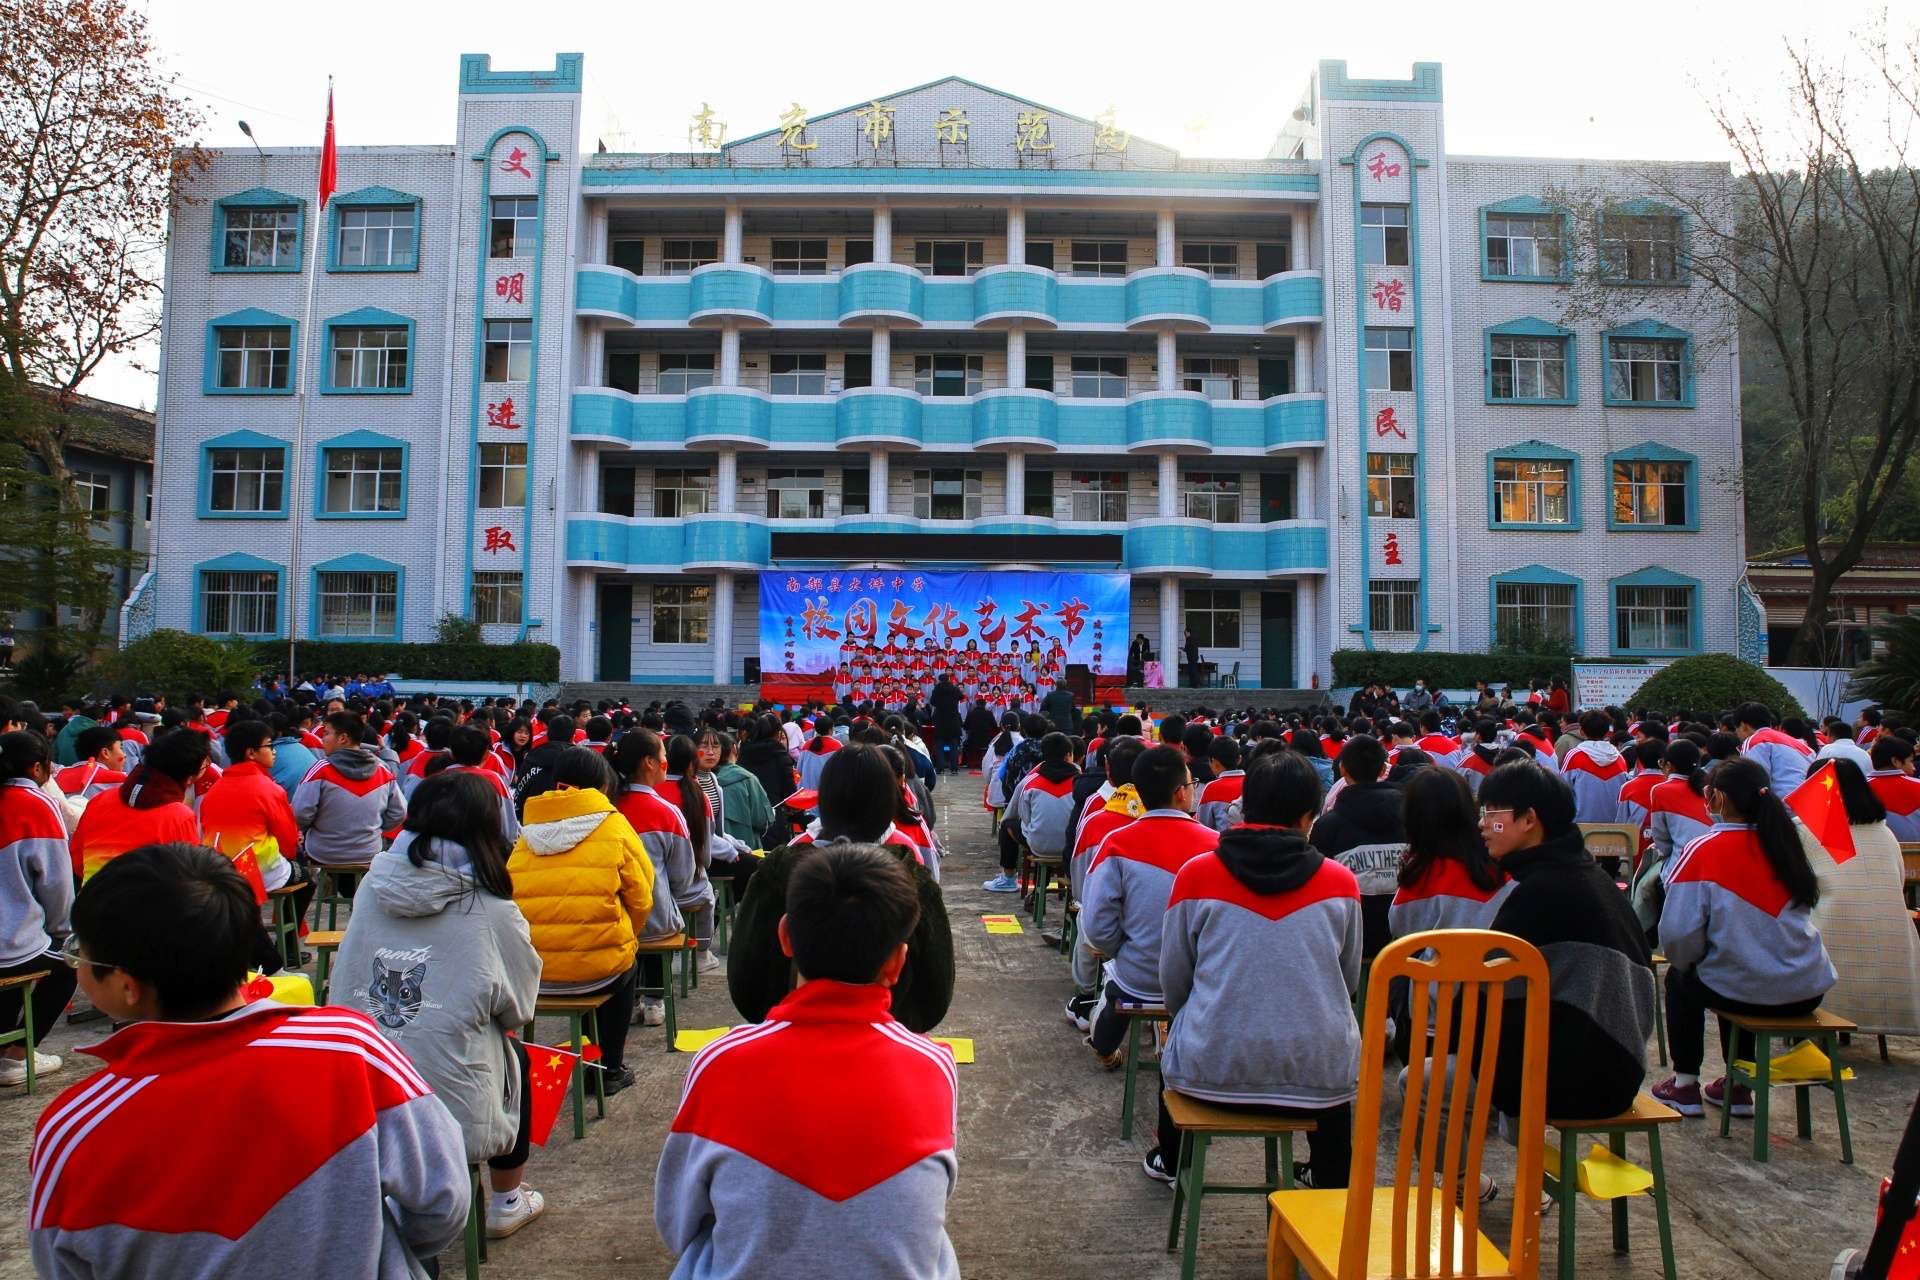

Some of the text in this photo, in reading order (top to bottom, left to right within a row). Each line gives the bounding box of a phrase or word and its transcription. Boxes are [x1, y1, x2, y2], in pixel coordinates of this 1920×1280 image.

[689, 101, 1208, 152] 南充市示范高
[800, 595, 1090, 648] 校园文化艺术节
